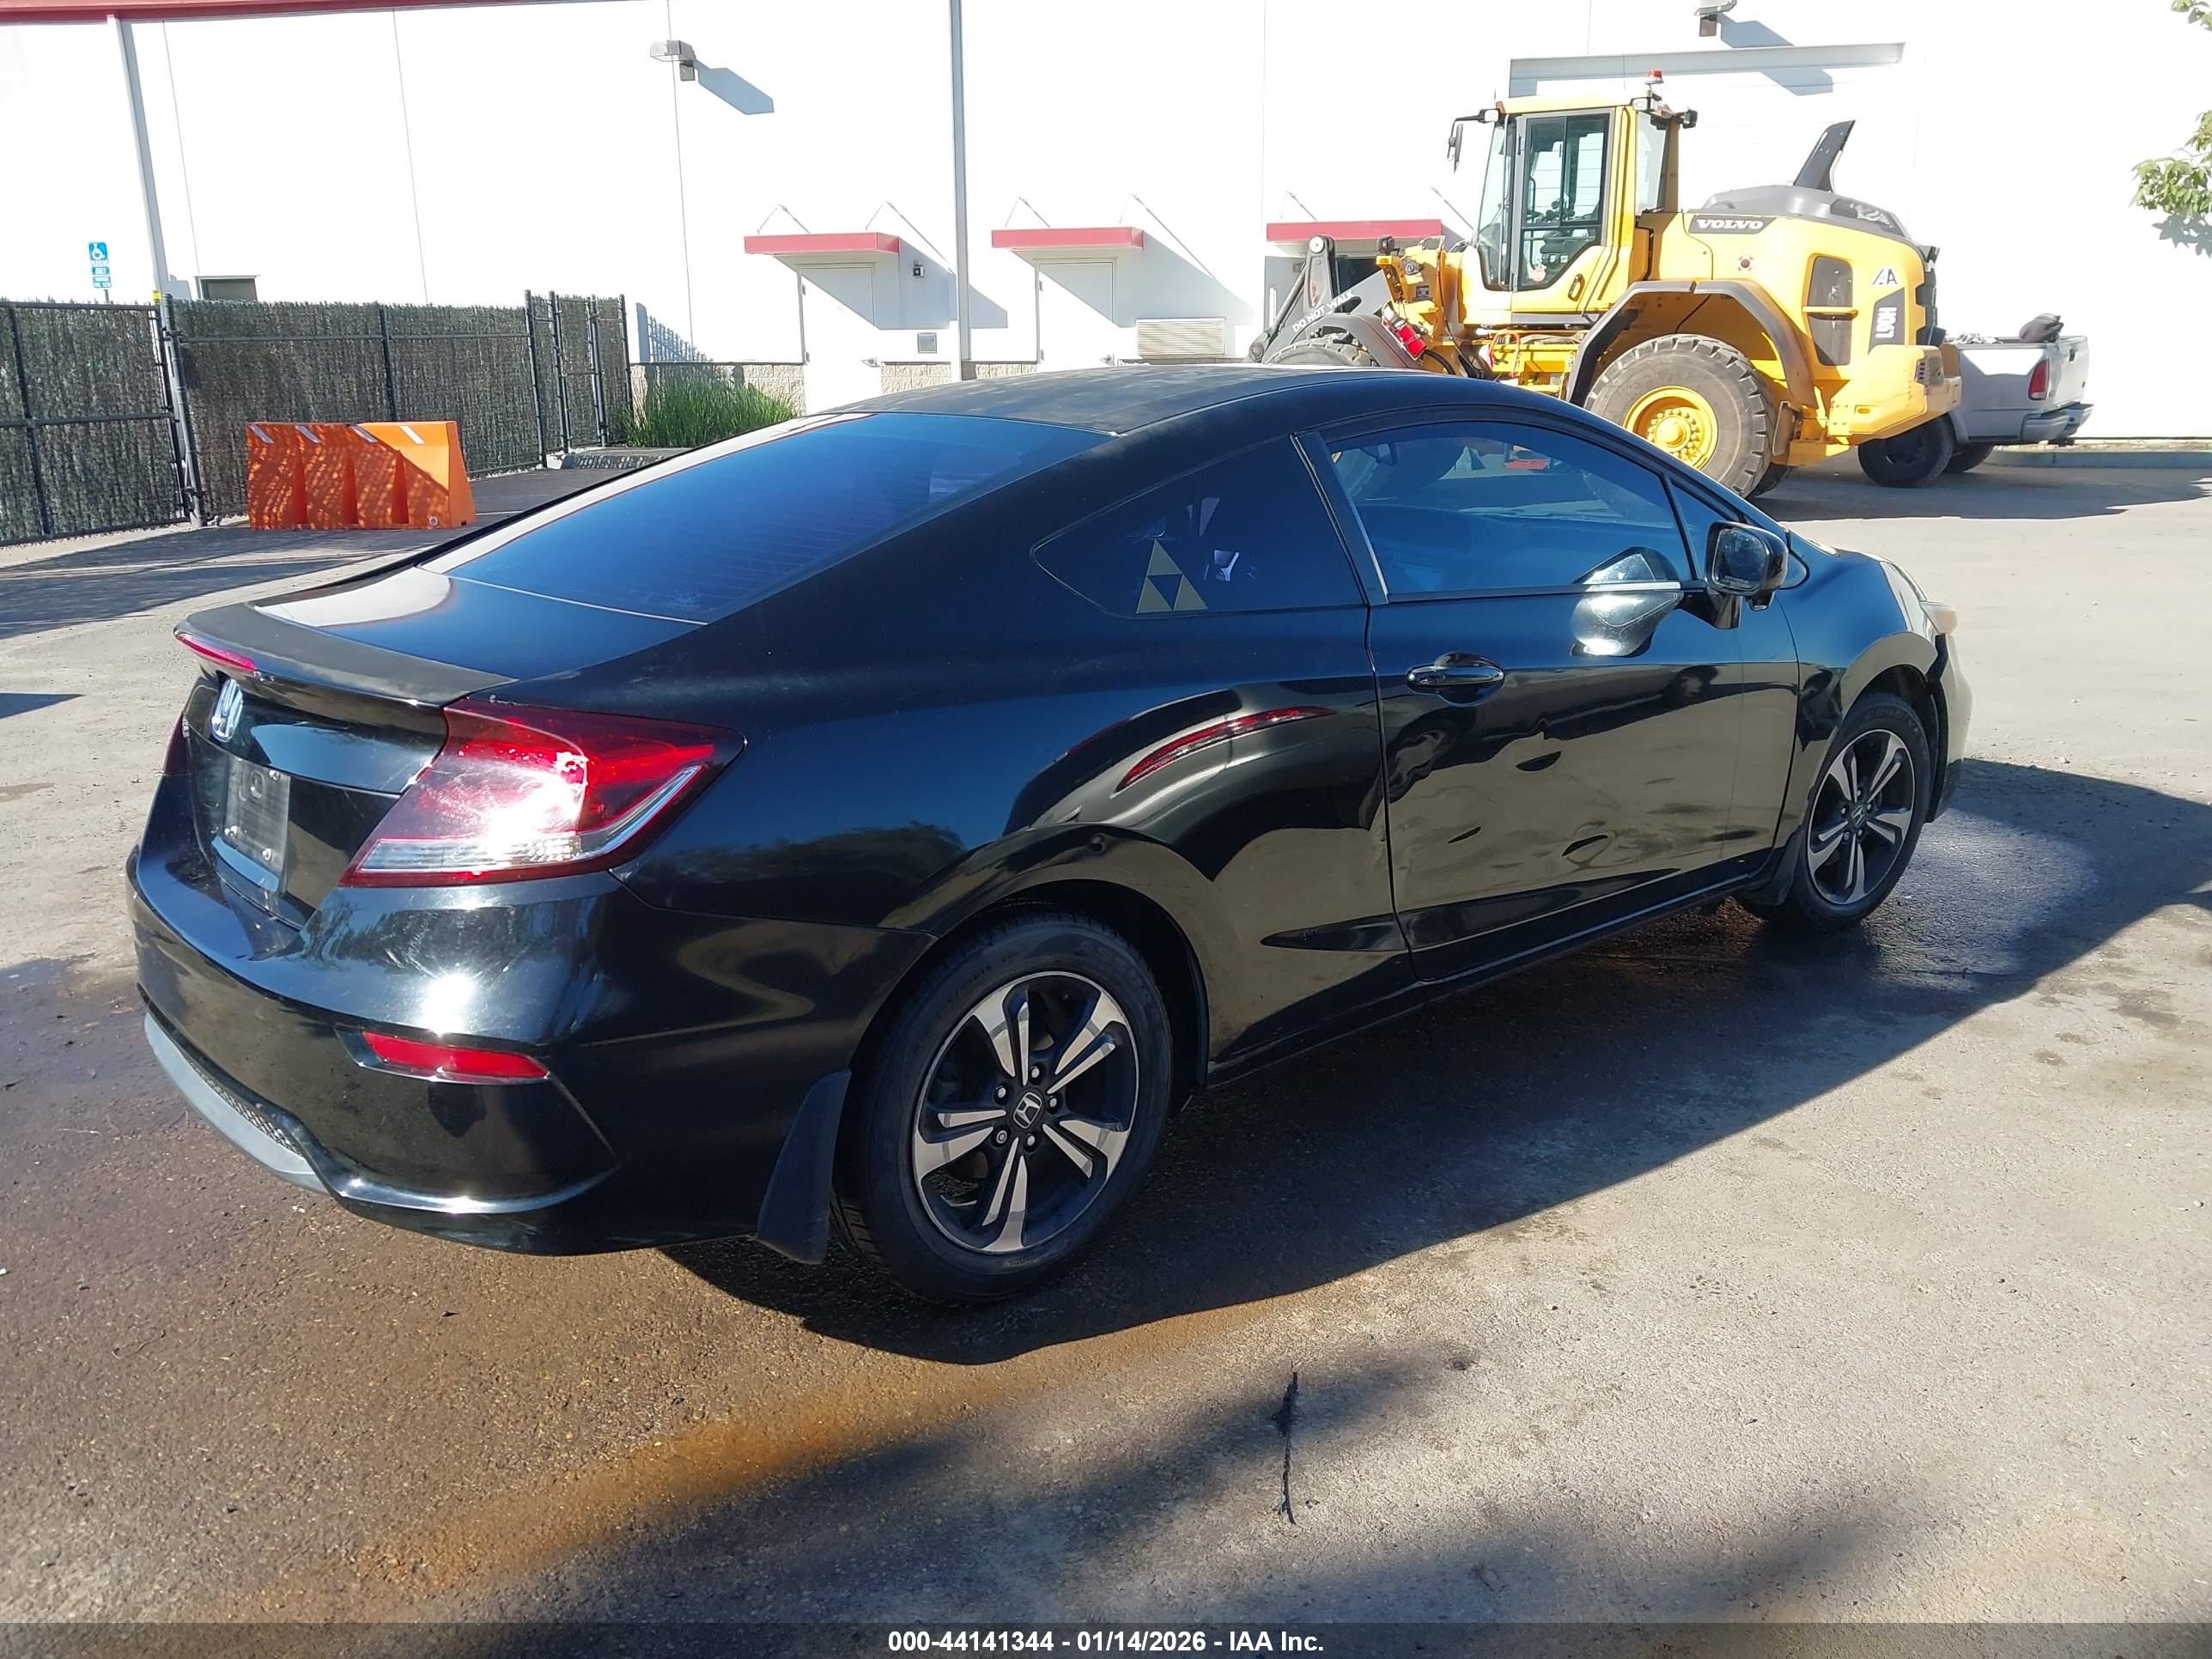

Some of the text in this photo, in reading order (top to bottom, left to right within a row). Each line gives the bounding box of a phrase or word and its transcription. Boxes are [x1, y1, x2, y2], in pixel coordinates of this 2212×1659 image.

[1697, 219, 1764, 230] VOLVO
[1291, 290, 1354, 333] DO NOT WALK
[1875, 307, 1897, 338] L90H
